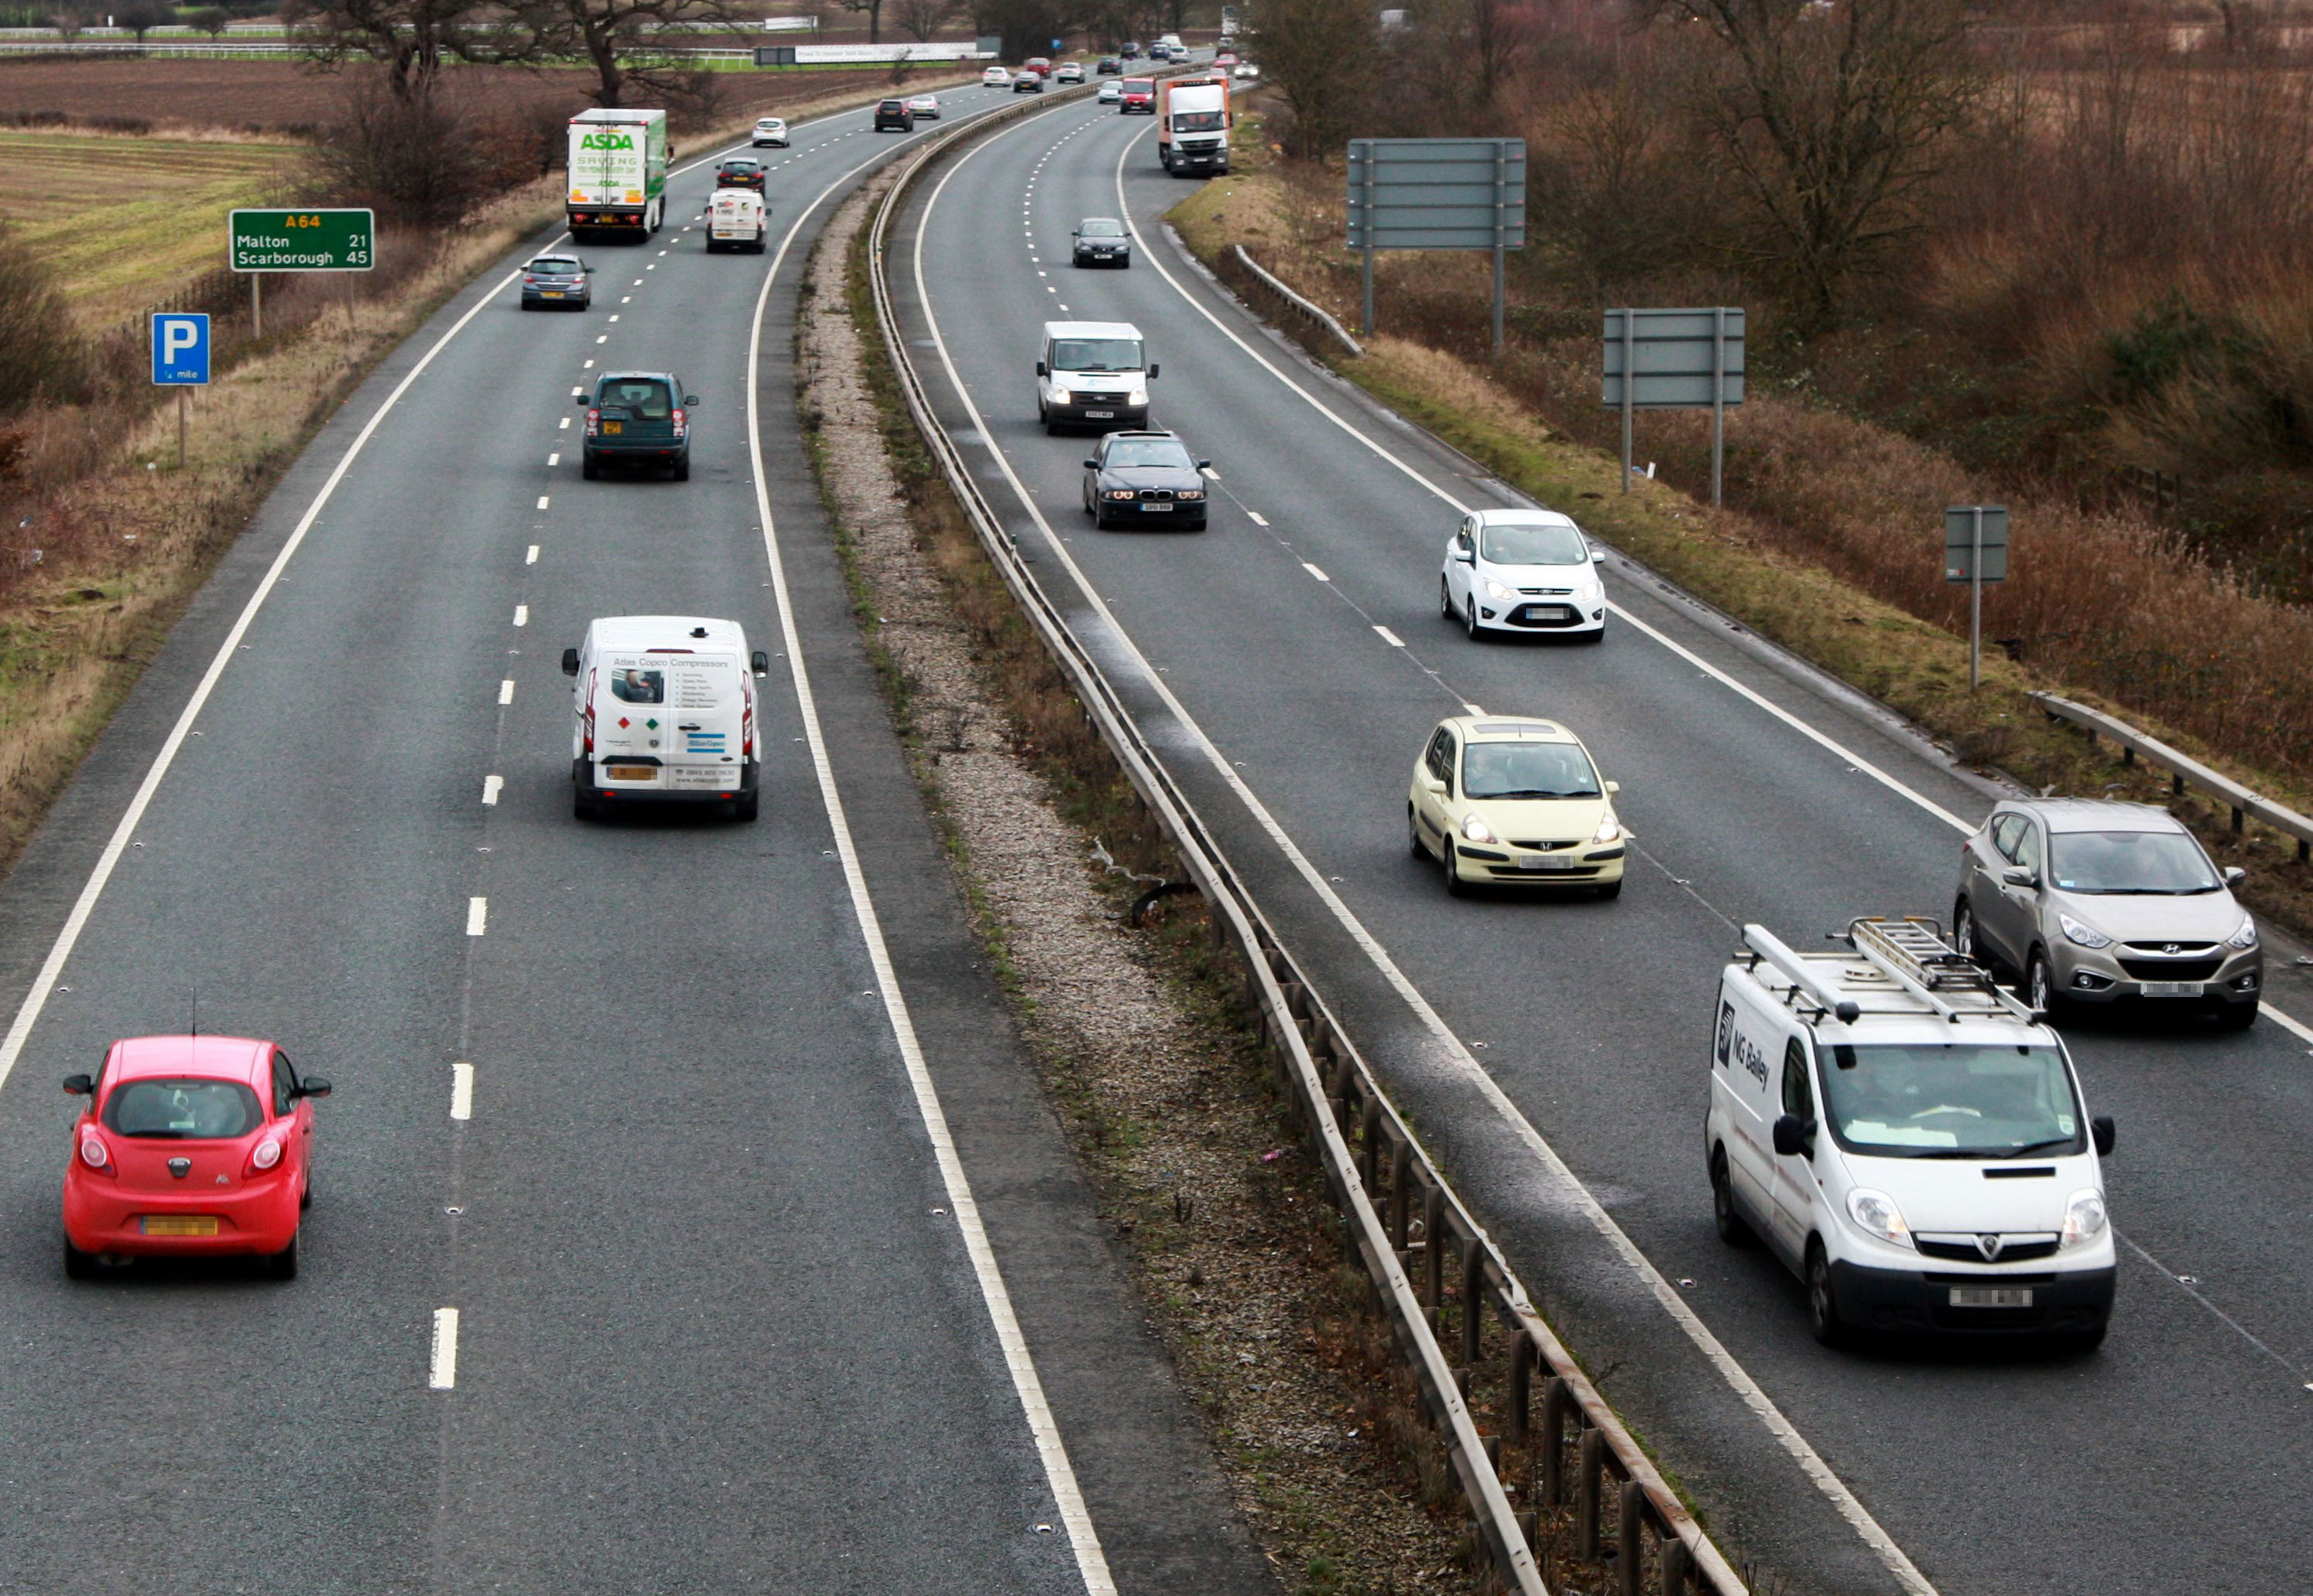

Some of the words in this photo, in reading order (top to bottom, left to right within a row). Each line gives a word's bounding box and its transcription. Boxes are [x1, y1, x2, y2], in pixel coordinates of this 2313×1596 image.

[580, 133, 634, 151] ASDA
[577, 157, 637, 165] SAVING
[286, 215, 320, 228] A64
[237, 235, 290, 248] Malton
[349, 234, 366, 248] 21
[238, 251, 334, 266] Scarborough
[346, 251, 368, 264] 45
[164, 320, 198, 365] P
[177, 370, 198, 379] mile
[614, 658, 636, 666] Atlas
[639, 658, 668, 668] Copco
[670, 658, 729, 668] Compressors
[1733, 1029, 1746, 1065] NG
[1746, 1041, 1769, 1093] Bailey
